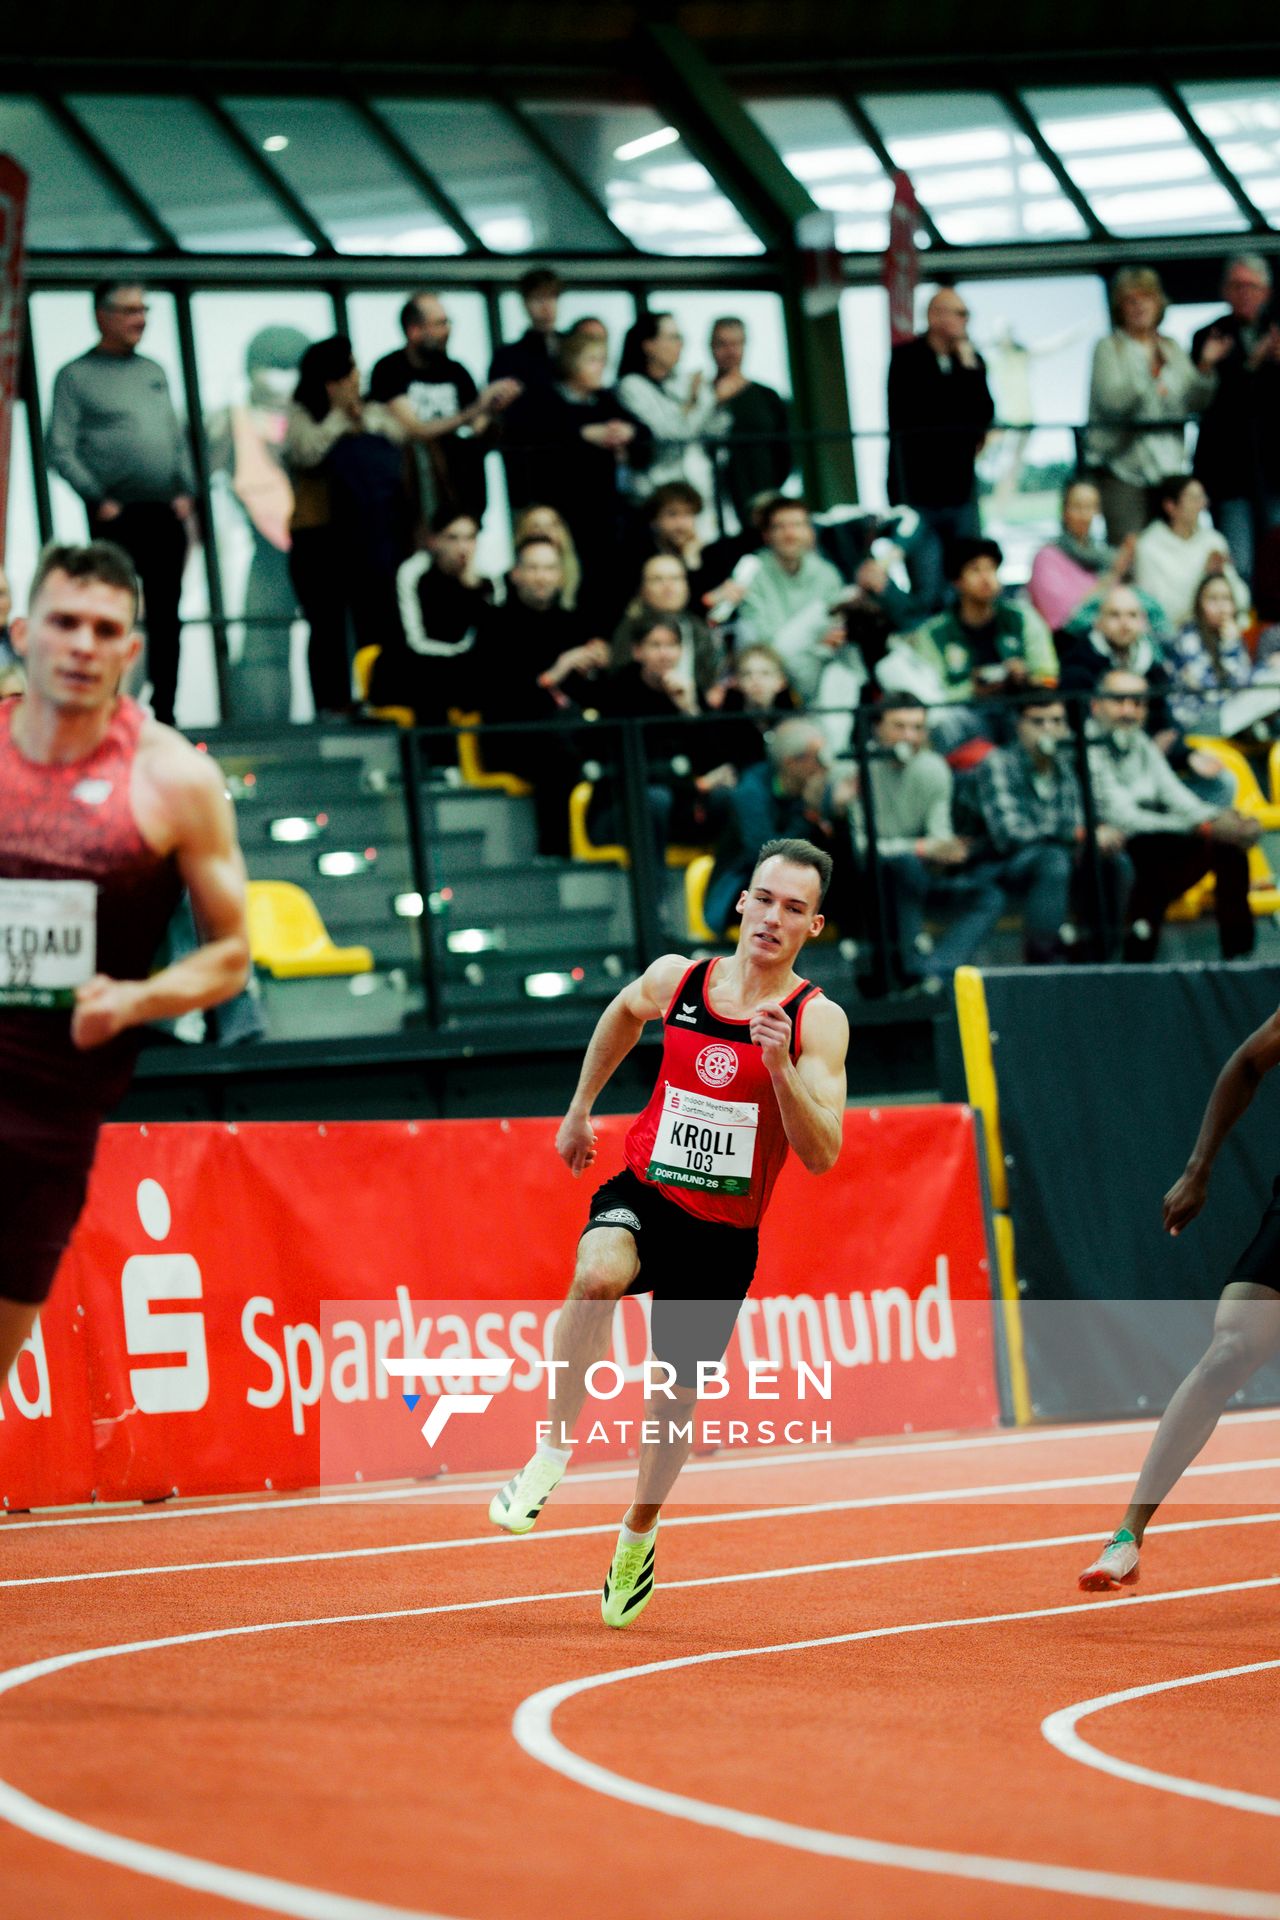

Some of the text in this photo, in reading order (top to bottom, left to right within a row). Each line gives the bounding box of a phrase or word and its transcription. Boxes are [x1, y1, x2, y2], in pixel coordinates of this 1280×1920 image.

[0, 926, 82, 956] EDAU
[706, 1101, 734, 1113] Meeting
[670, 1121, 736, 1156] KROLL
[686, 1150, 713, 1173] 103
[655, 1167, 706, 1186] DORTMUND
[706, 1179, 720, 1189] 26
[241, 1254, 957, 1436] Sparkass Dtmund
